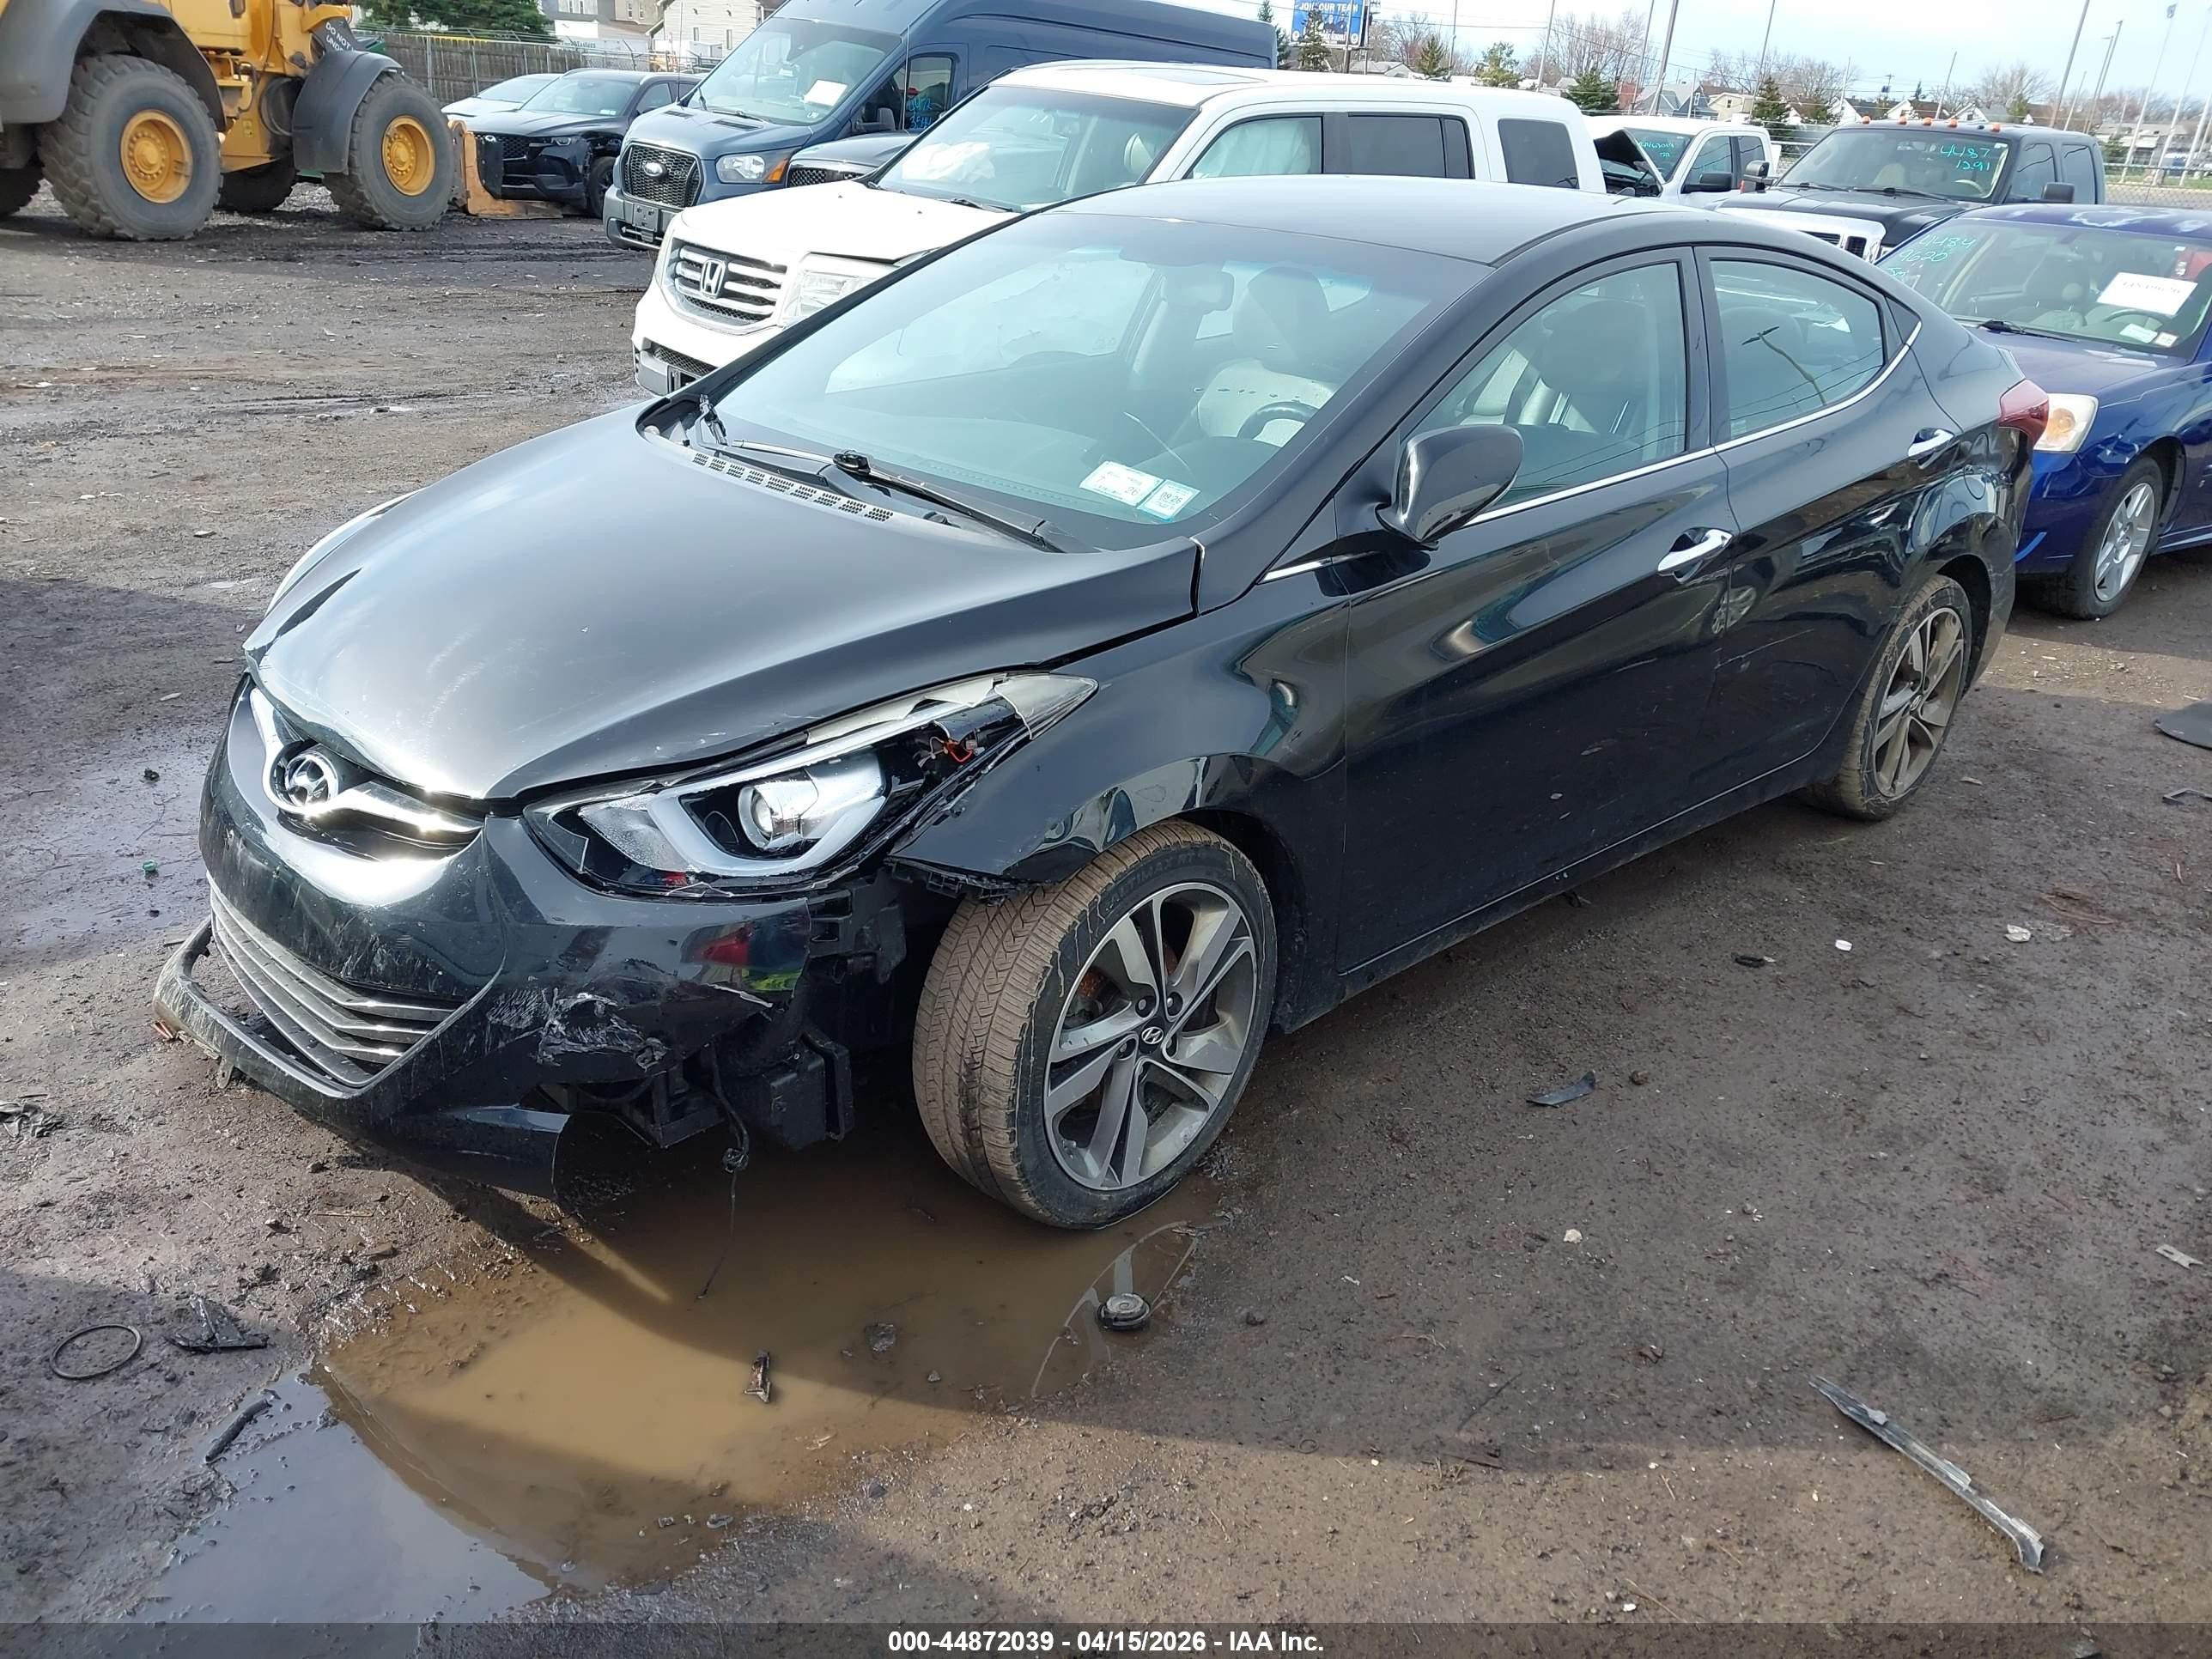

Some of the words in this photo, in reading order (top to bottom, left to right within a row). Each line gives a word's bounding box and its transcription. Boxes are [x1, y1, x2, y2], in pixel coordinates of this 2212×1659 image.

[1319, 3, 1335, 12] OUR
[1338, 4, 1358, 13] TEAM
[325, 21, 337, 35] DO
[337, 33, 351, 50] NOT
[326, 34, 343, 52] UND
[1940, 143, 1990, 159] 4487
[1955, 160, 1990, 172] 1291
